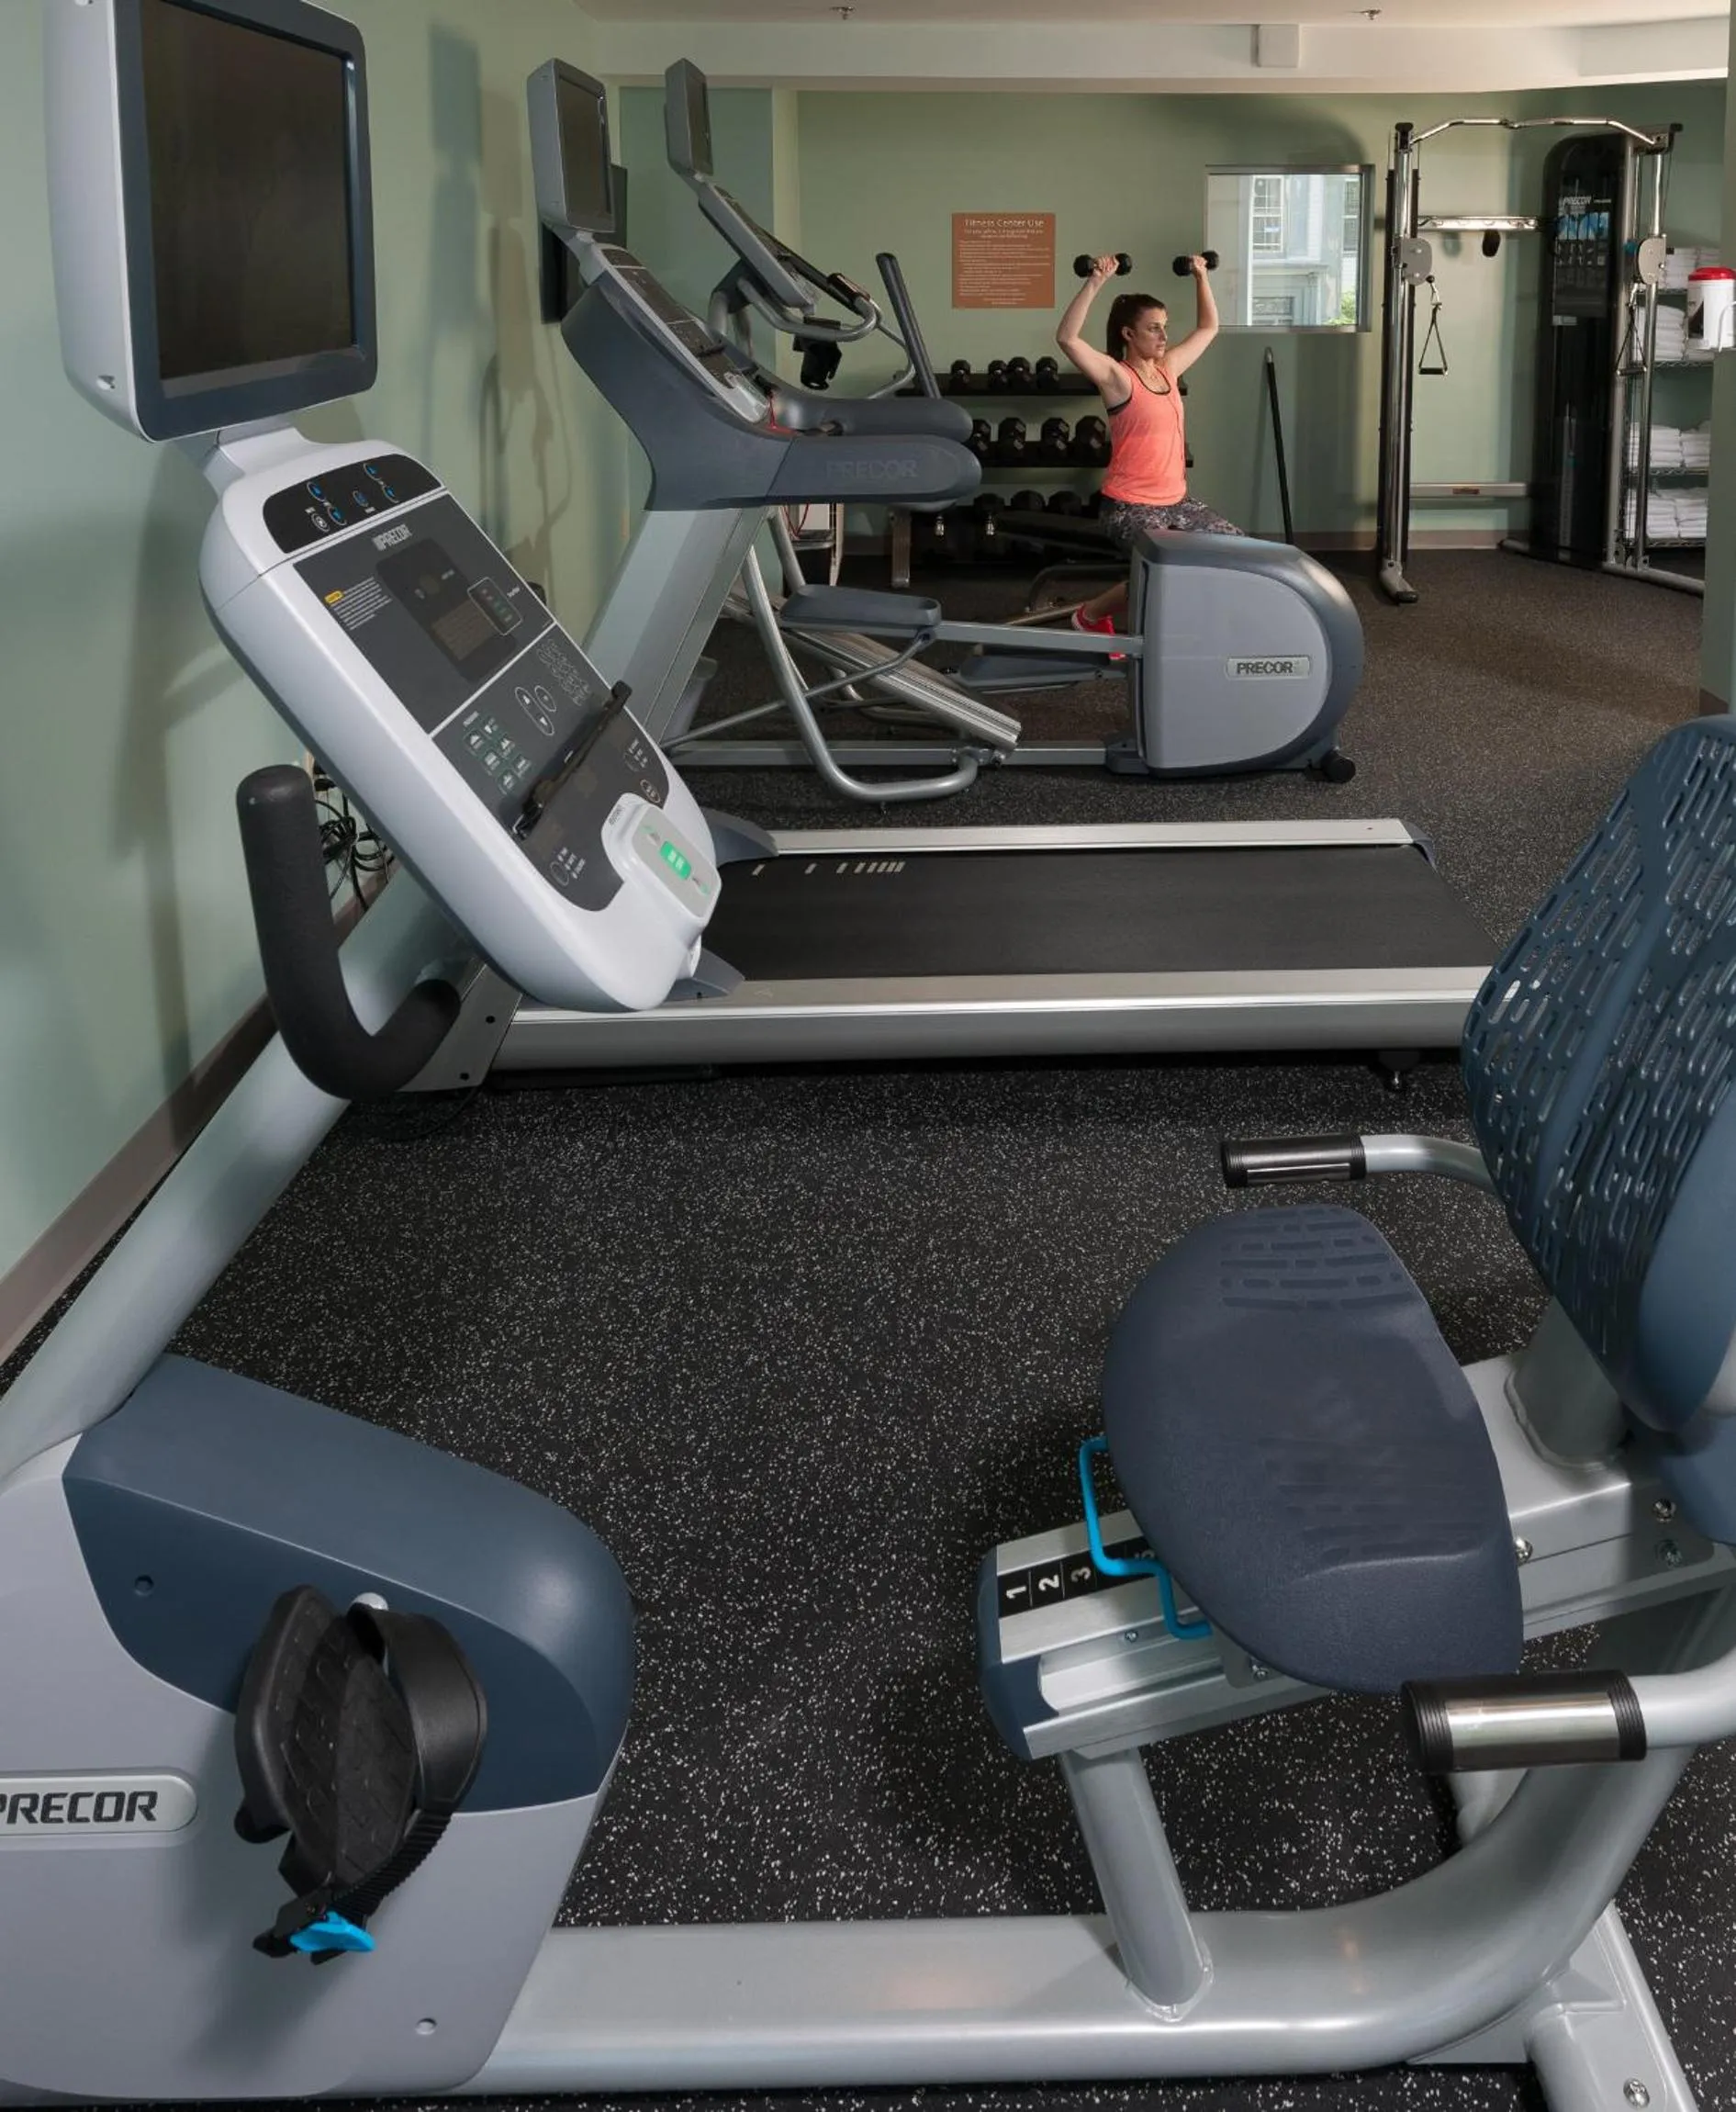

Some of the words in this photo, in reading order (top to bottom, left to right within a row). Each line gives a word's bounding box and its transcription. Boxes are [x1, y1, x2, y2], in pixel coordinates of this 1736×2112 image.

[826, 460, 918, 479] PRECOR
[1237, 661, 1294, 674] PRECOR
[1006, 1585, 1027, 1599] 1
[1038, 1574, 1059, 1591] 2
[1070, 1567, 1092, 1582] 3
[0, 1792, 158, 1825] RECOR
